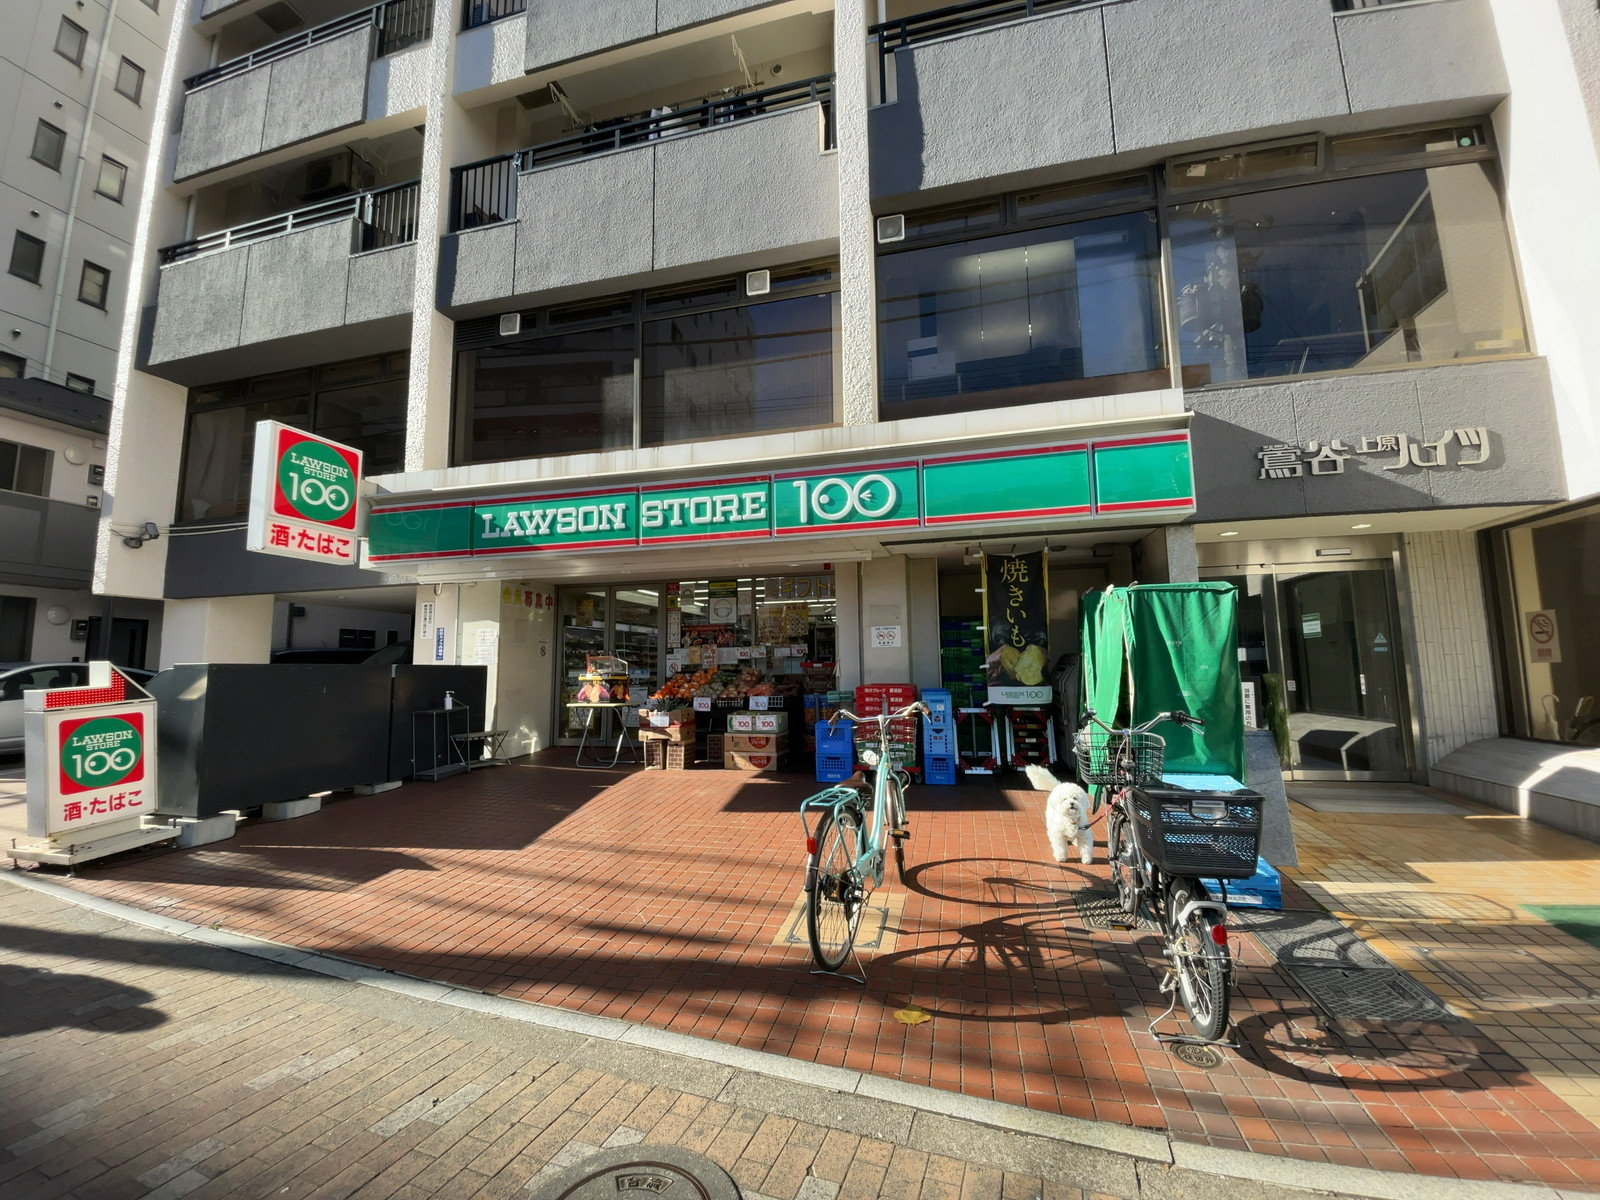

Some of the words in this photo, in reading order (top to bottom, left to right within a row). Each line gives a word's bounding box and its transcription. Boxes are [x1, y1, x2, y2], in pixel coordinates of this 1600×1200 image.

[290, 452, 349, 478] LAWSON
[304, 466, 337, 482] STORE
[289, 472, 349, 511] 100
[481, 503, 626, 539] LAWSON
[641, 491, 767, 526] STORE
[793, 474, 897, 524] 100
[270, 523, 350, 558] 酒・たばこ
[1000, 558, 1029, 648] 焼きいも
[1025, 690, 1044, 699] 100
[72, 730, 133, 747] LAWSON
[761, 720, 774, 728] 100
[86, 740, 120, 752] STORE
[71, 747, 136, 779] 100
[63, 790, 143, 822] 酒・たばこ
